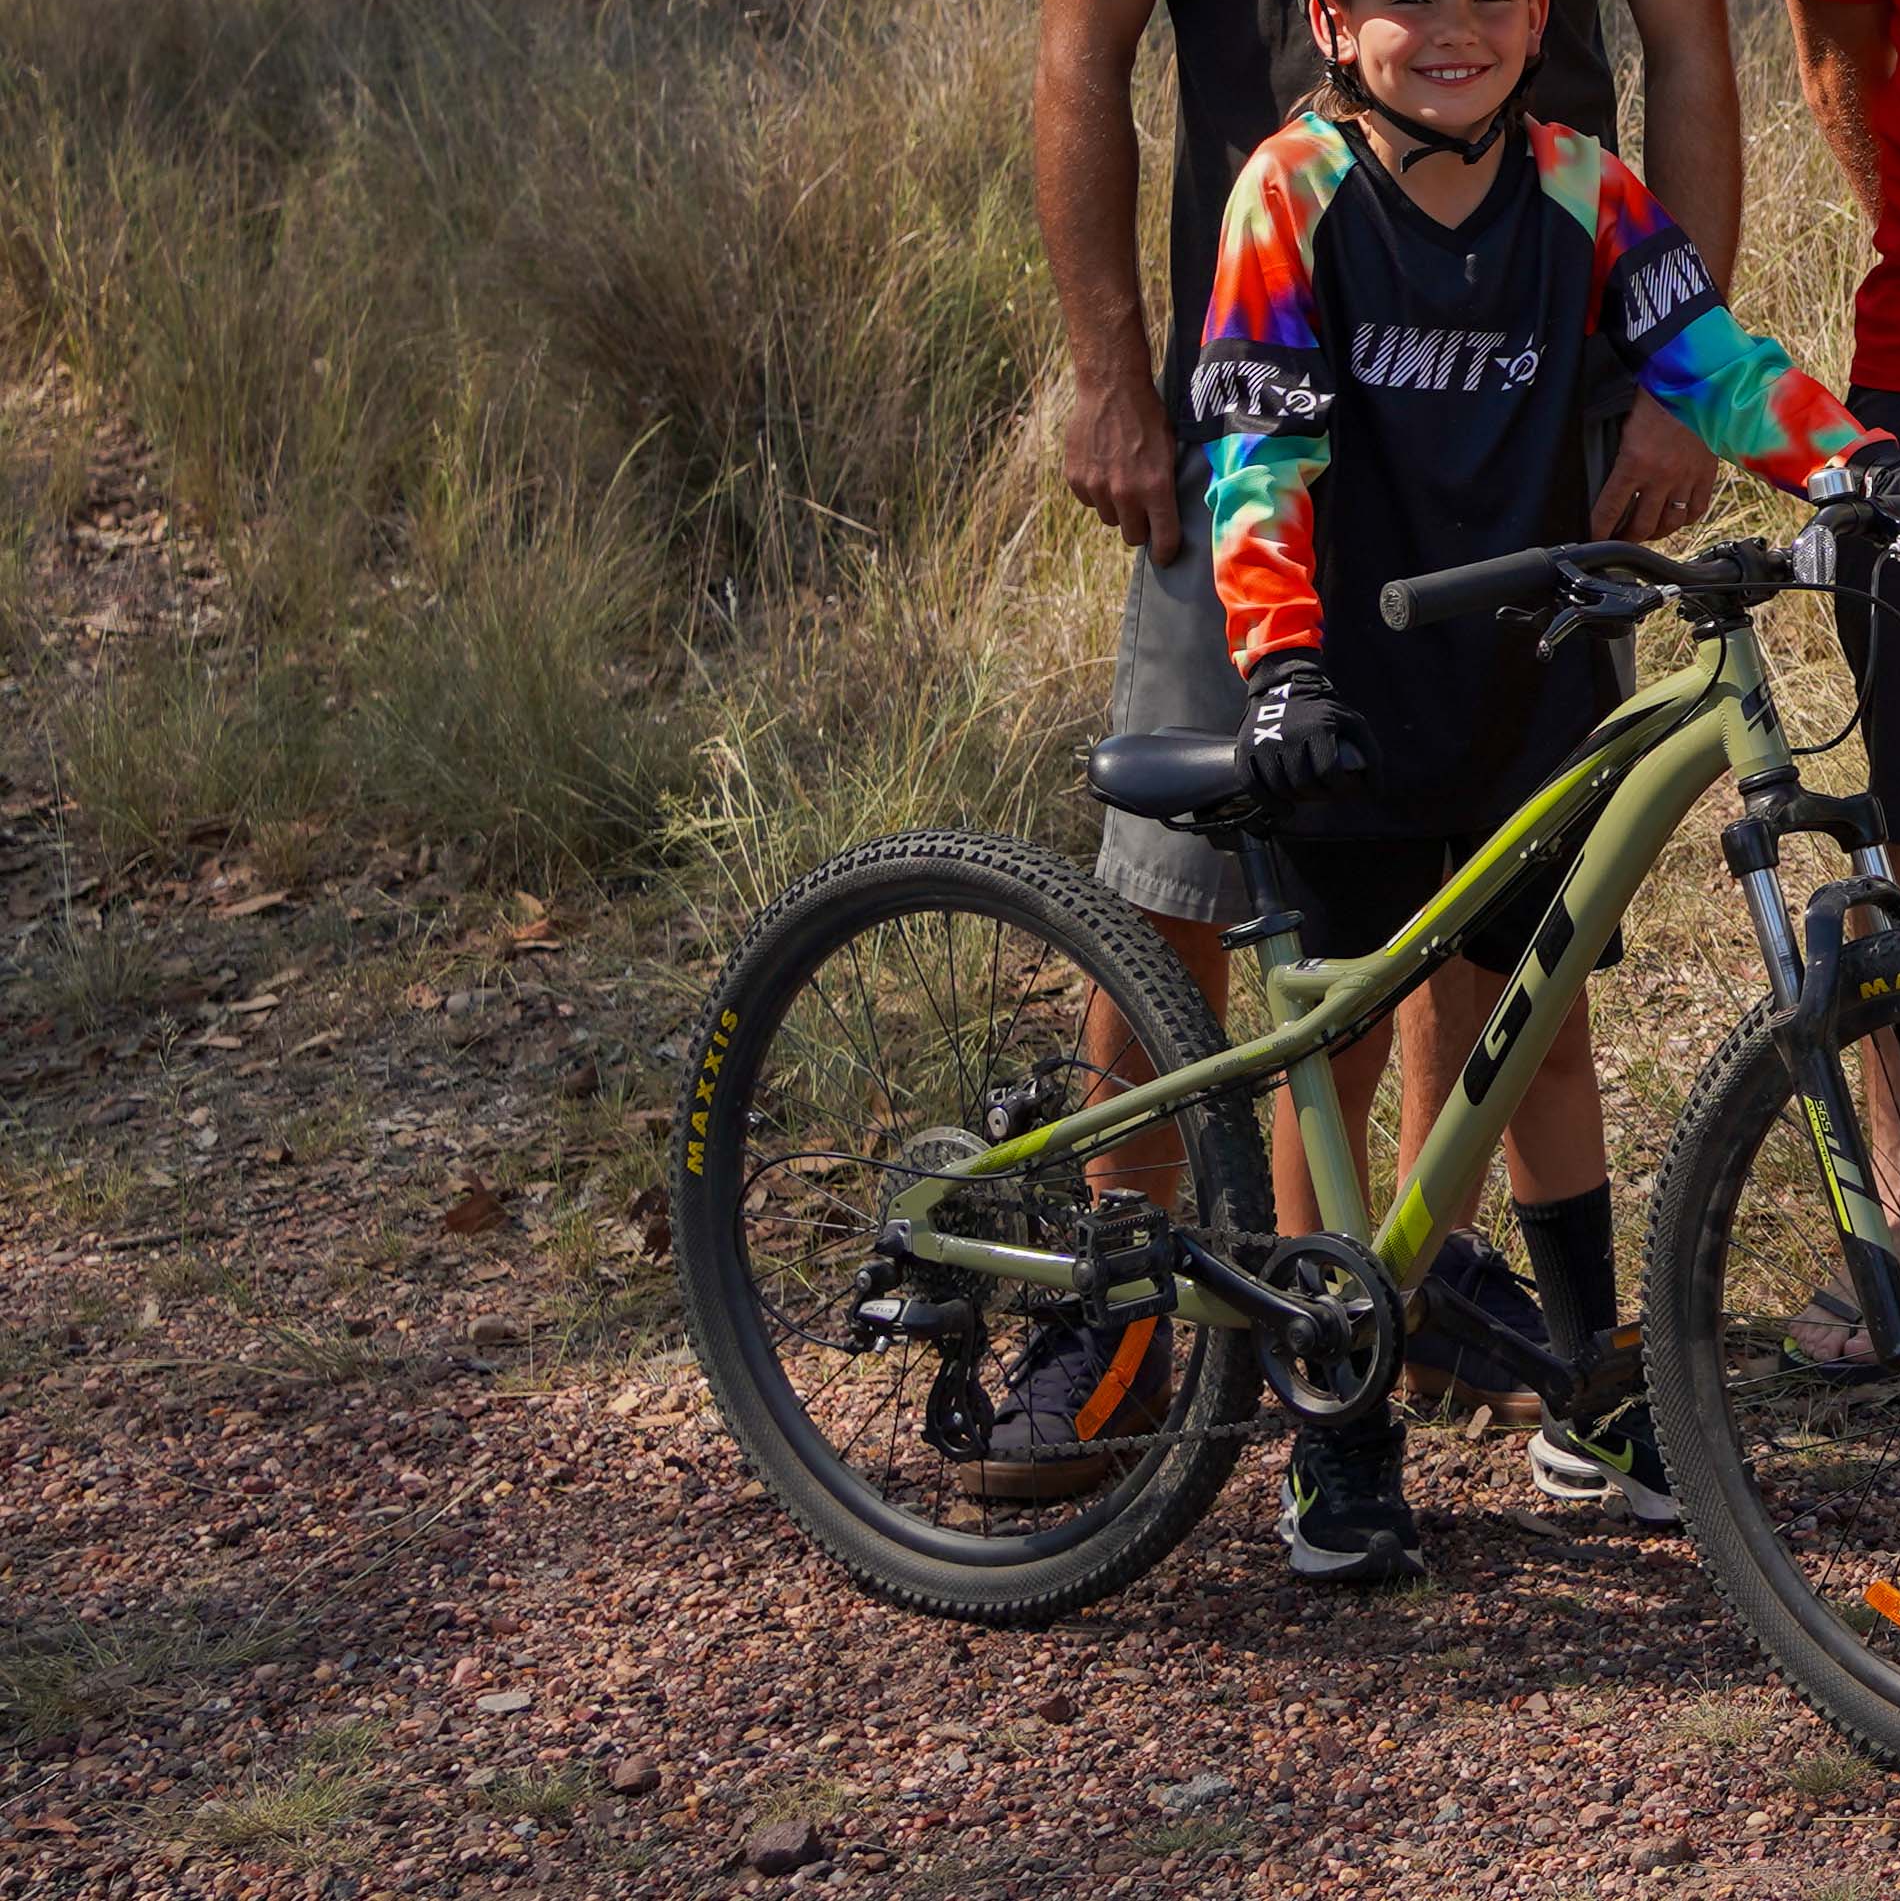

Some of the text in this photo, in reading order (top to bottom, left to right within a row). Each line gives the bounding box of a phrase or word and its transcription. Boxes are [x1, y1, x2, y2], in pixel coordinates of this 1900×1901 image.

[1350, 322, 1507, 391] UNIT
[1253, 682, 1293, 746] FOX
[687, 1007, 738, 1177] MAXXIS
